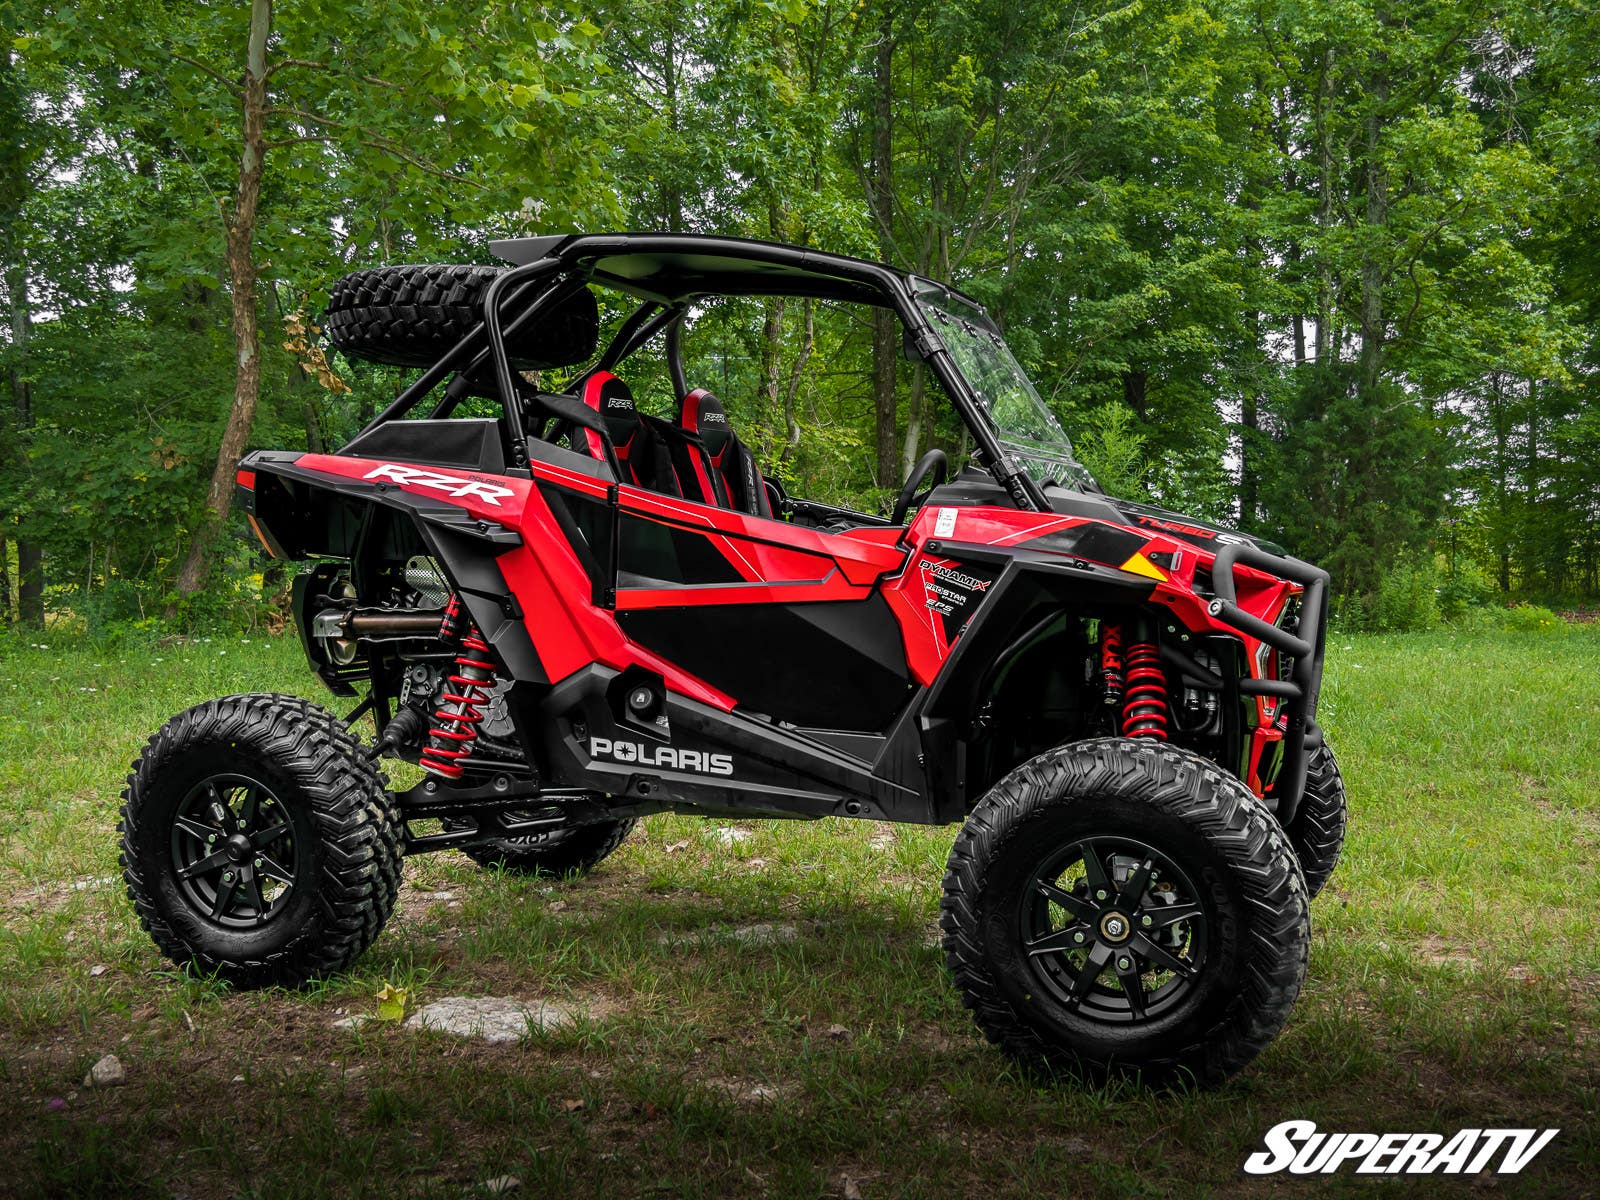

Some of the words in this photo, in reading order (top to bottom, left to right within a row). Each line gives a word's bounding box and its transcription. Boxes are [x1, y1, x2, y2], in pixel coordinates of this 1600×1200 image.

[608, 397, 633, 410] RZR
[703, 412, 725, 423] RZR
[362, 464, 515, 506] RZR
[1137, 516, 1216, 539] TURBO
[919, 559, 992, 592] DYNAMIX
[926, 598, 954, 612] EPS
[590, 736, 734, 776] POLARIS
